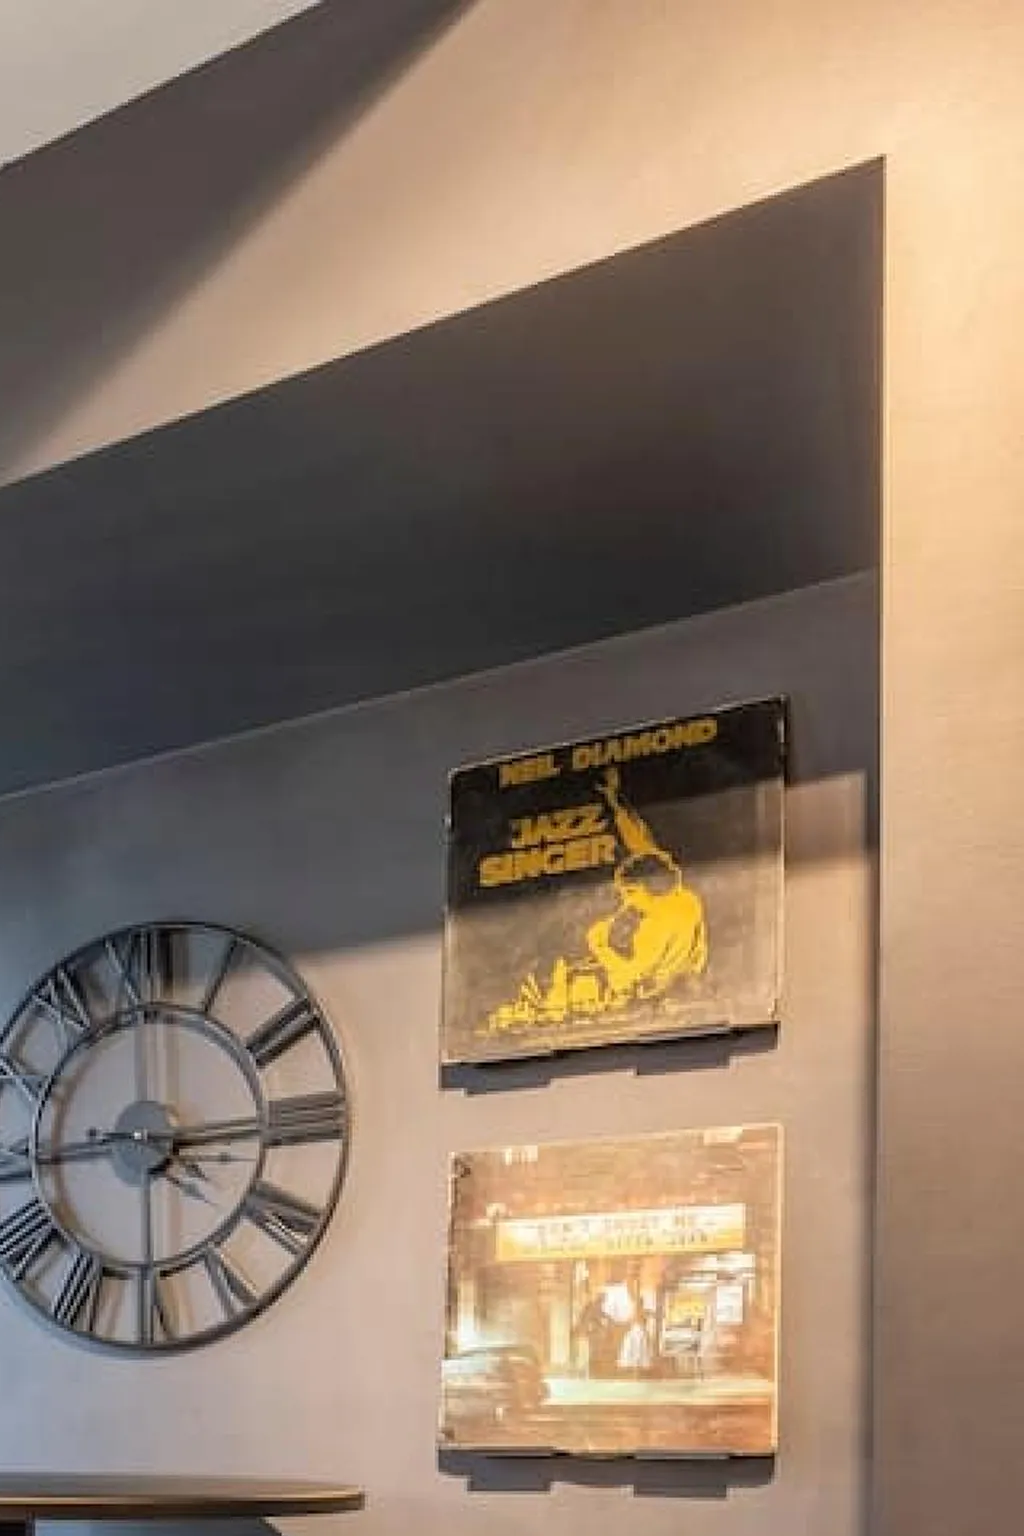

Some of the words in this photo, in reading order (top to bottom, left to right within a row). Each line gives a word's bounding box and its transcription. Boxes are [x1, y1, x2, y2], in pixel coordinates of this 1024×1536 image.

[499, 754, 561, 787] NEIL
[573, 719, 718, 769] DIAMOND
[510, 803, 608, 848] JAZZ
[478, 834, 616, 888] SINGER
